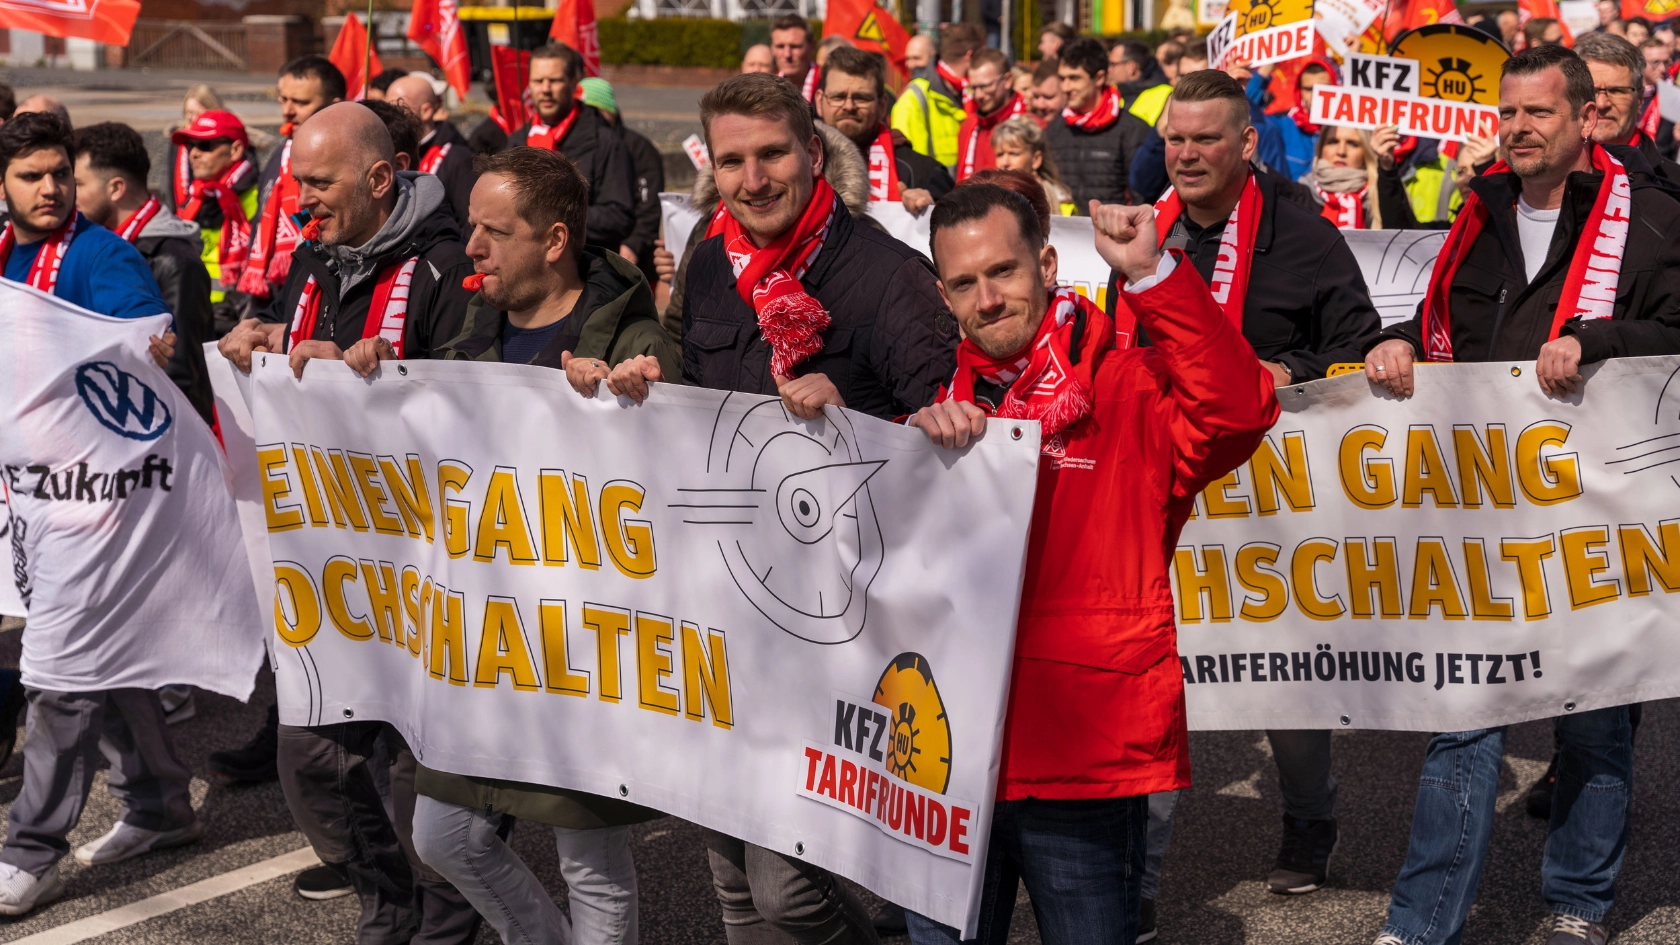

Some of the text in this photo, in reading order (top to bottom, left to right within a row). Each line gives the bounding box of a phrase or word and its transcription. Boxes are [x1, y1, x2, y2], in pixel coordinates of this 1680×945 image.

[1249, 11, 1267, 28] HU
[1351, 58, 1411, 93] KFZ
[1443, 79, 1466, 95] HU
[1318, 90, 1499, 139] TARIFRUND
[26, 453, 173, 503] Zukunft
[1337, 419, 1584, 510] GANG
[256, 442, 657, 580] EINEN GANG
[1173, 517, 1680, 624] HSCHALTEN
[272, 554, 734, 731] OCHSCHALTEN
[1180, 643, 1543, 691] ARIFERHÖHUNG JETZT!
[834, 699, 888, 763] KFZ
[896, 732, 910, 756] HU
[805, 746, 971, 855] TARIFRUNDE
